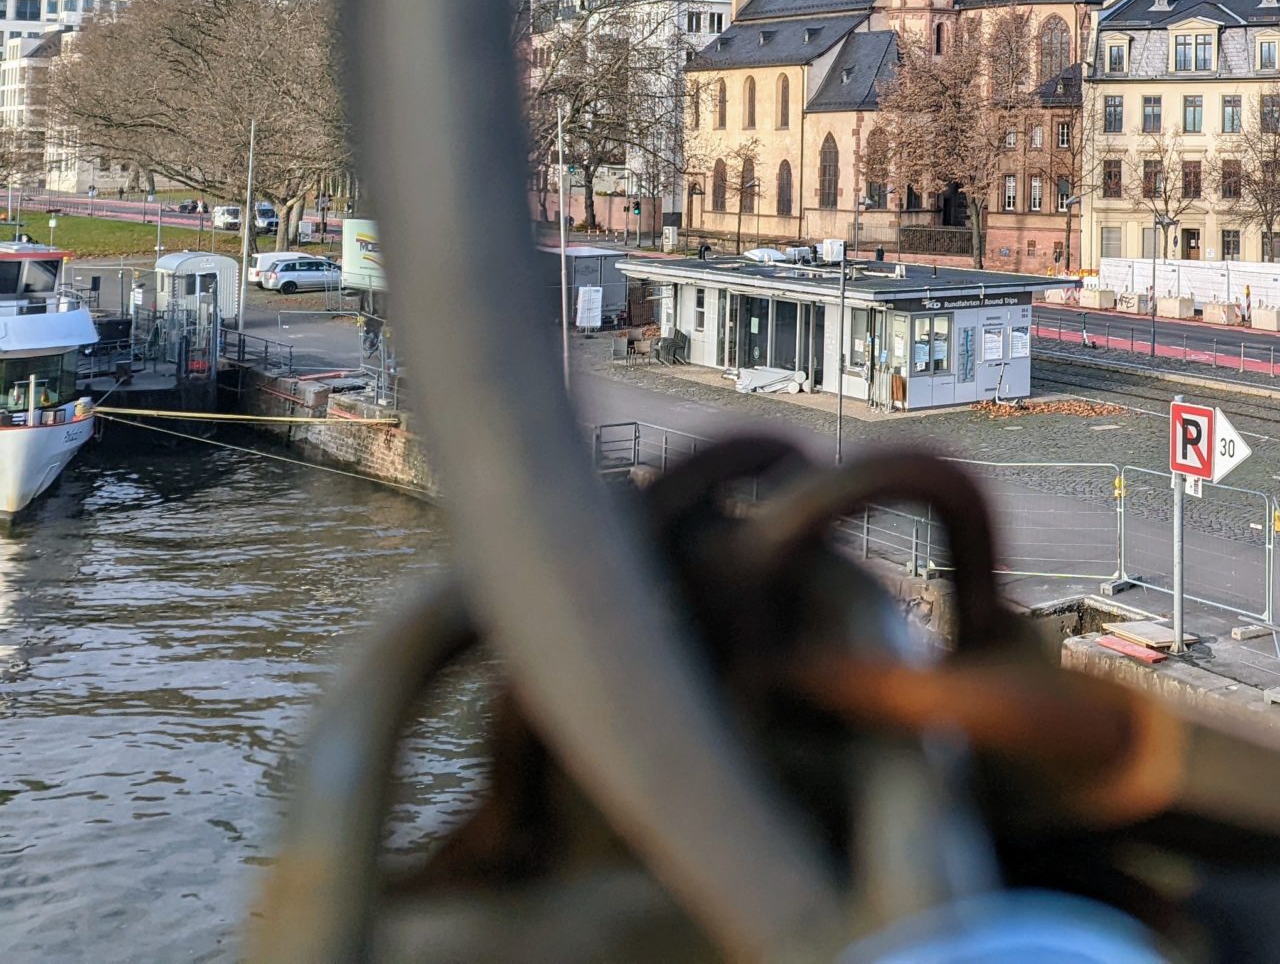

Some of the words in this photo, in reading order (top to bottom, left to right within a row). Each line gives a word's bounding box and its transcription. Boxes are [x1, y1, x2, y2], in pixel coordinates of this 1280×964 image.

[944, 300, 980, 308] Rundfahrten
[1182, 418, 1202, 460] P
[1220, 438, 1235, 458] 30
